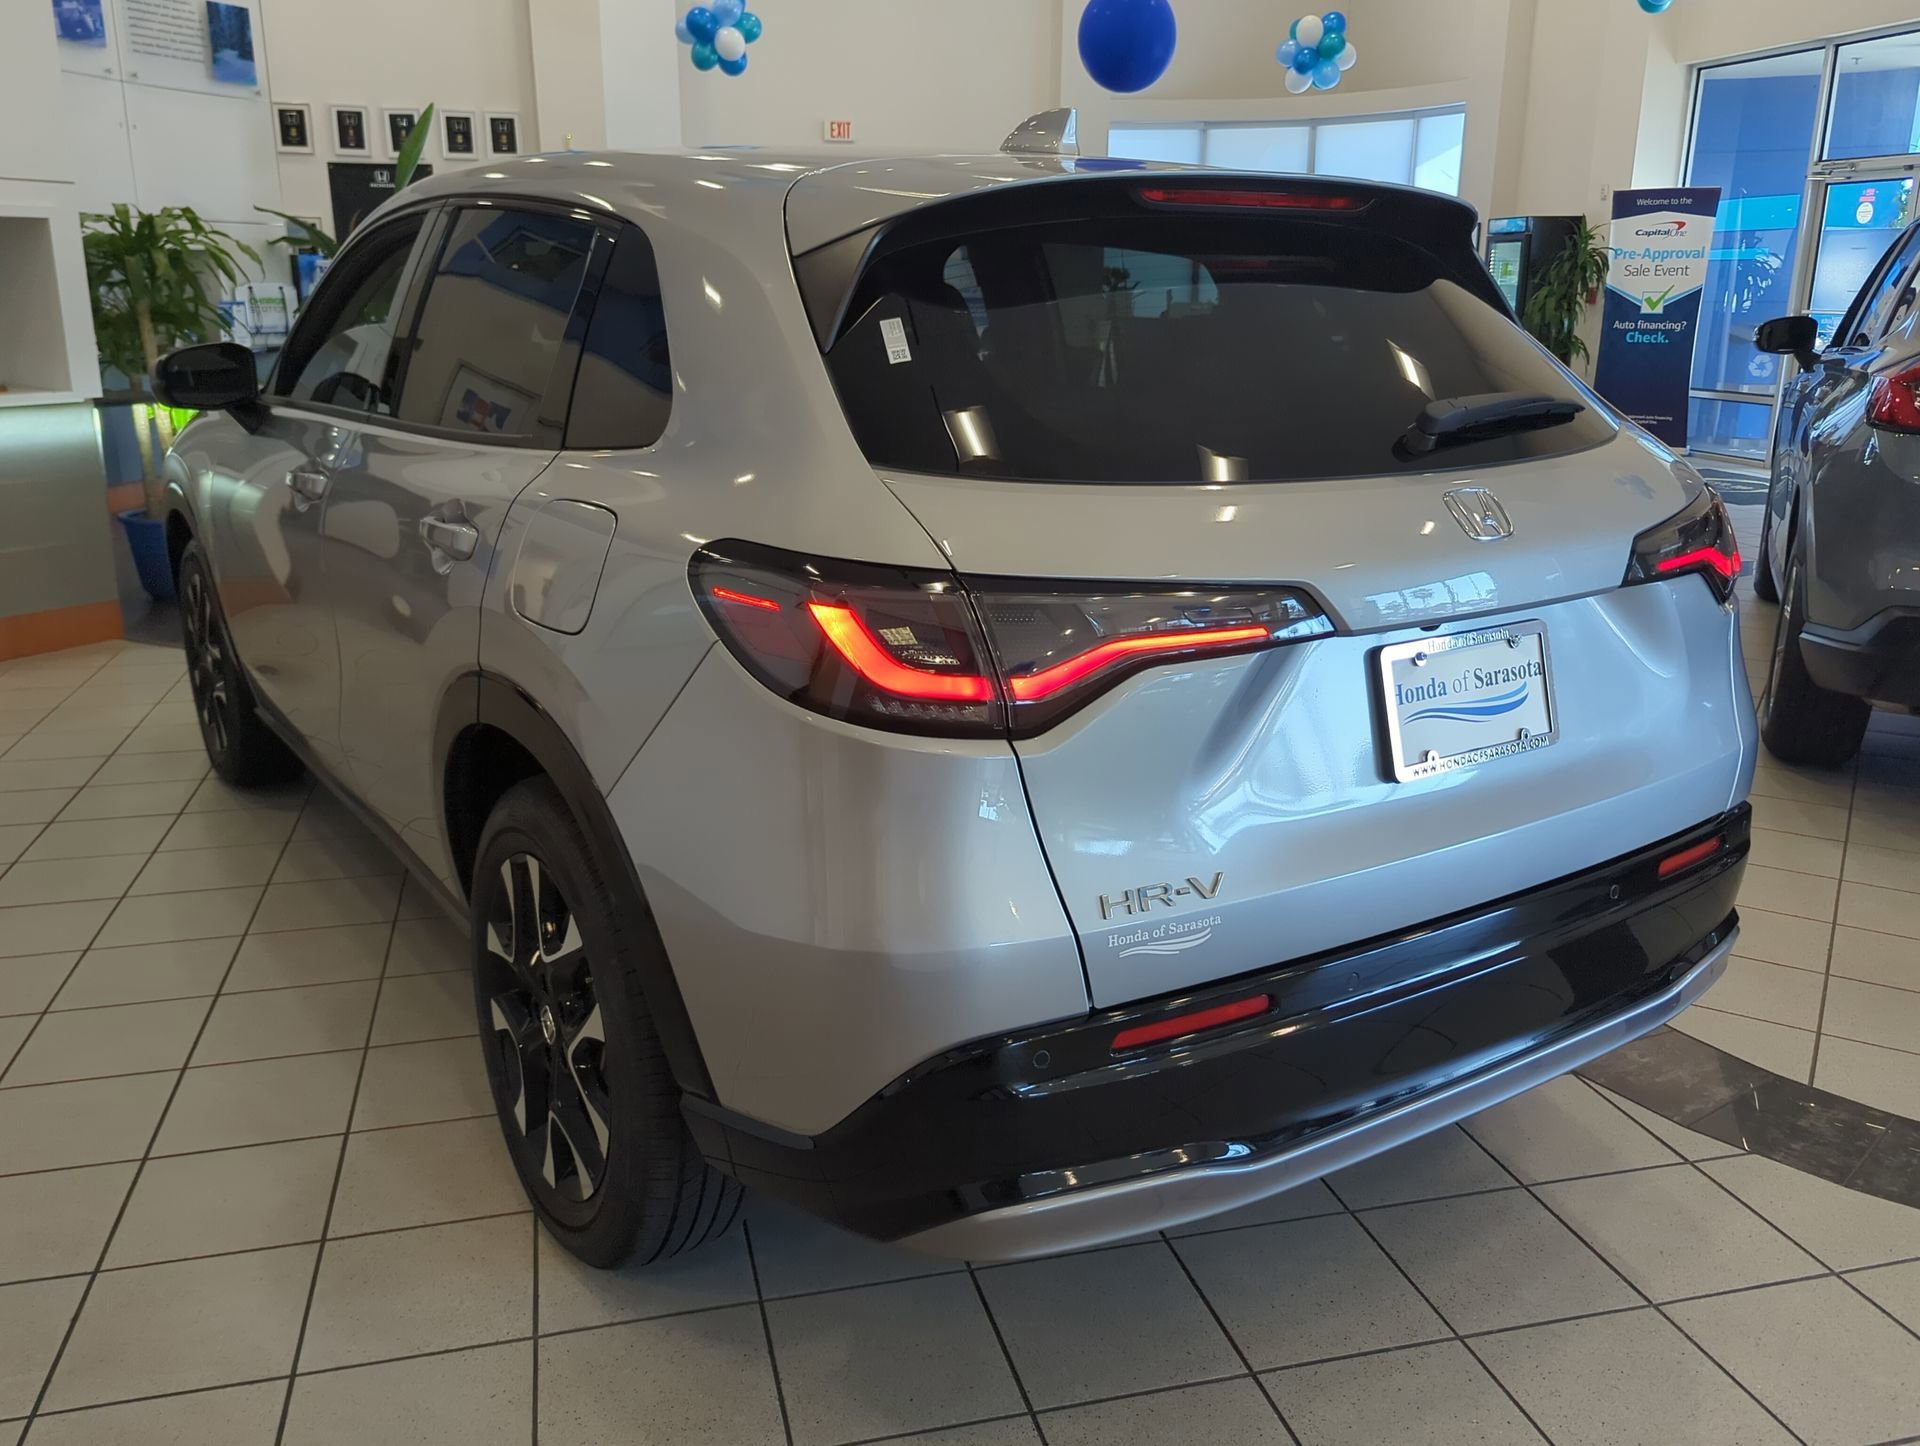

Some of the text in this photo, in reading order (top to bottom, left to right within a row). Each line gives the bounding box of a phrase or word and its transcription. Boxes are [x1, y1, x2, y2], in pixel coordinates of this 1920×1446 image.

[830, 121, 851, 139] EXIT
[1636, 198, 1669, 206] Welcome
[1680, 197, 1692, 205] the
[1614, 246, 1705, 262] Pre-Approval
[1624, 264, 1690, 277] Sale Event
[1613, 320, 1687, 332] Auto financing?
[1626, 331, 1669, 343] Check.
[1470, 628, 1510, 646] Sarasota
[1453, 669, 1470, 694] of
[1473, 659, 1542, 689] Sarasota
[1099, 871, 1224, 920] HR-V
[1108, 915, 1222, 947] Honda of Sarasota
